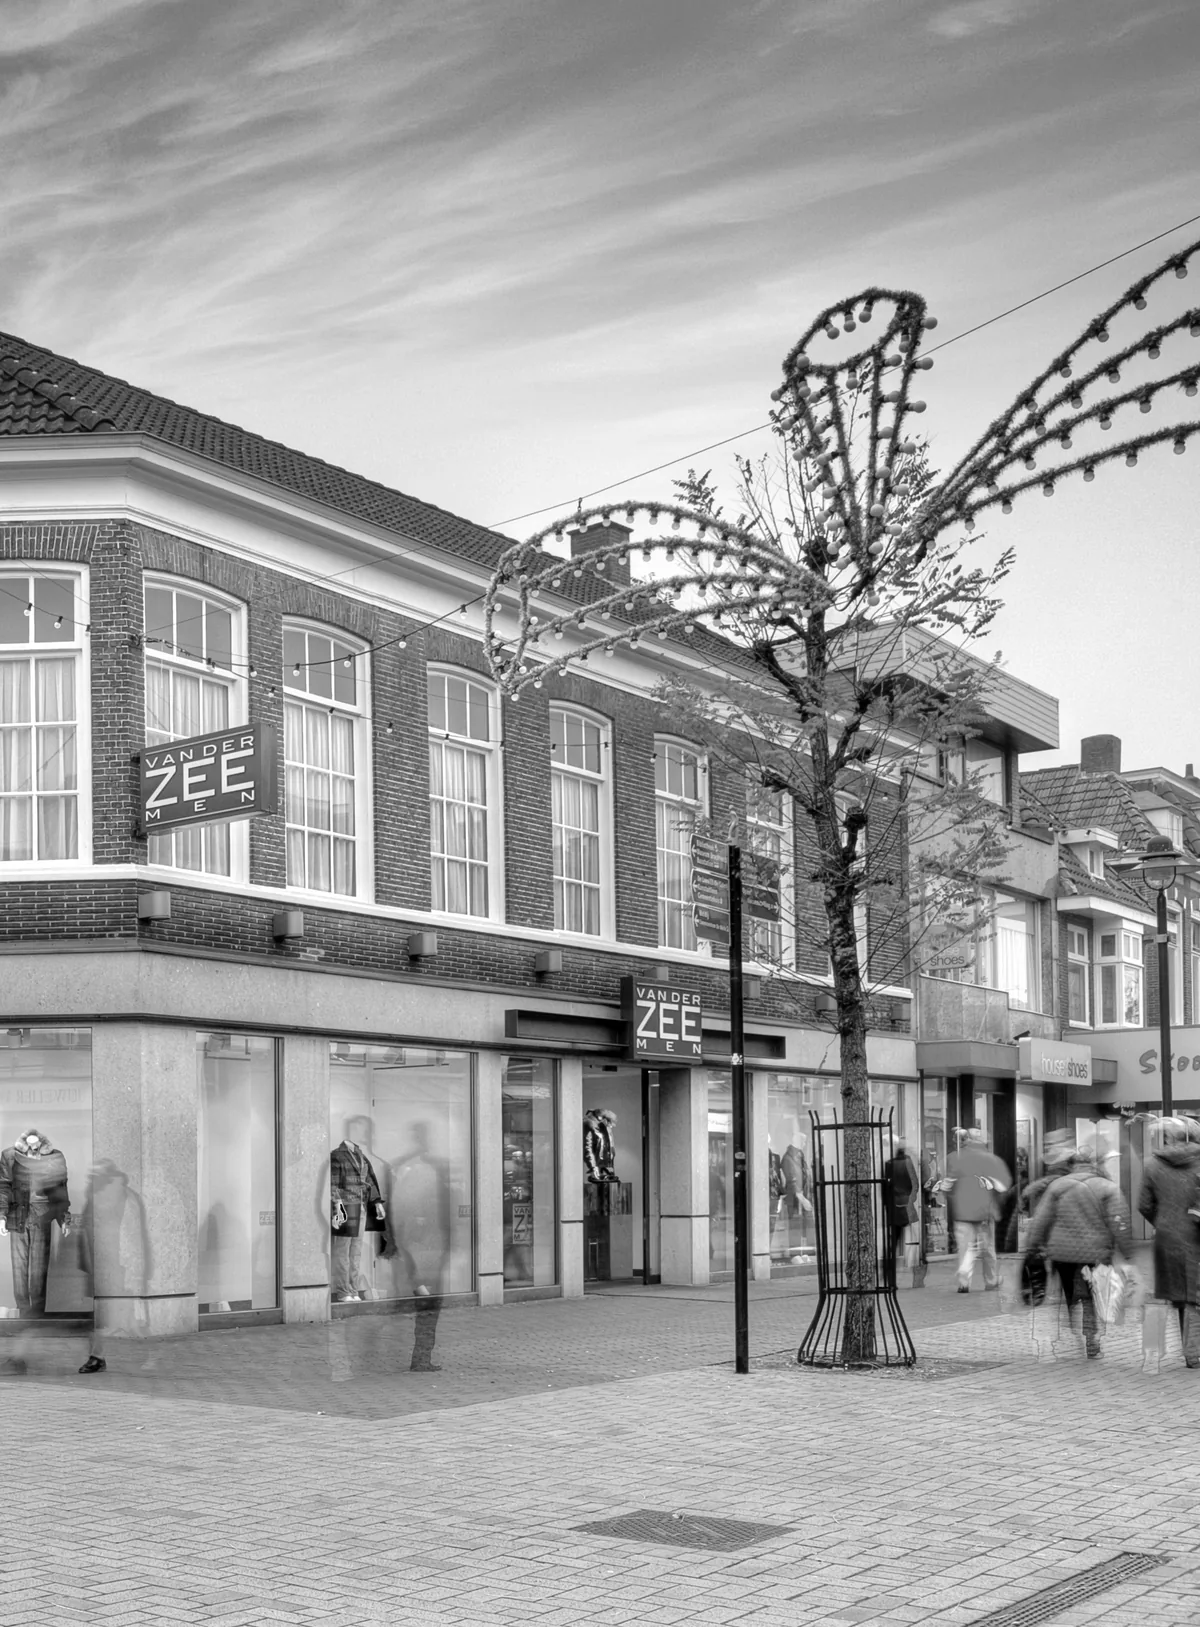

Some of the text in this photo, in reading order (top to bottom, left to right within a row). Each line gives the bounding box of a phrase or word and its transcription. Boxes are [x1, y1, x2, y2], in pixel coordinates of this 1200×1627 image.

[145, 735, 254, 769] VAN DER
[145, 747, 255, 809] ZEE
[145, 789, 255, 822] MEN
[930, 955, 965, 967] shoes
[636, 987, 701, 1006] VAN DER
[636, 999, 701, 1042] ZEE
[636, 1038, 702, 1054] MEN
[1040, 1051, 1088, 1079] house shoes
